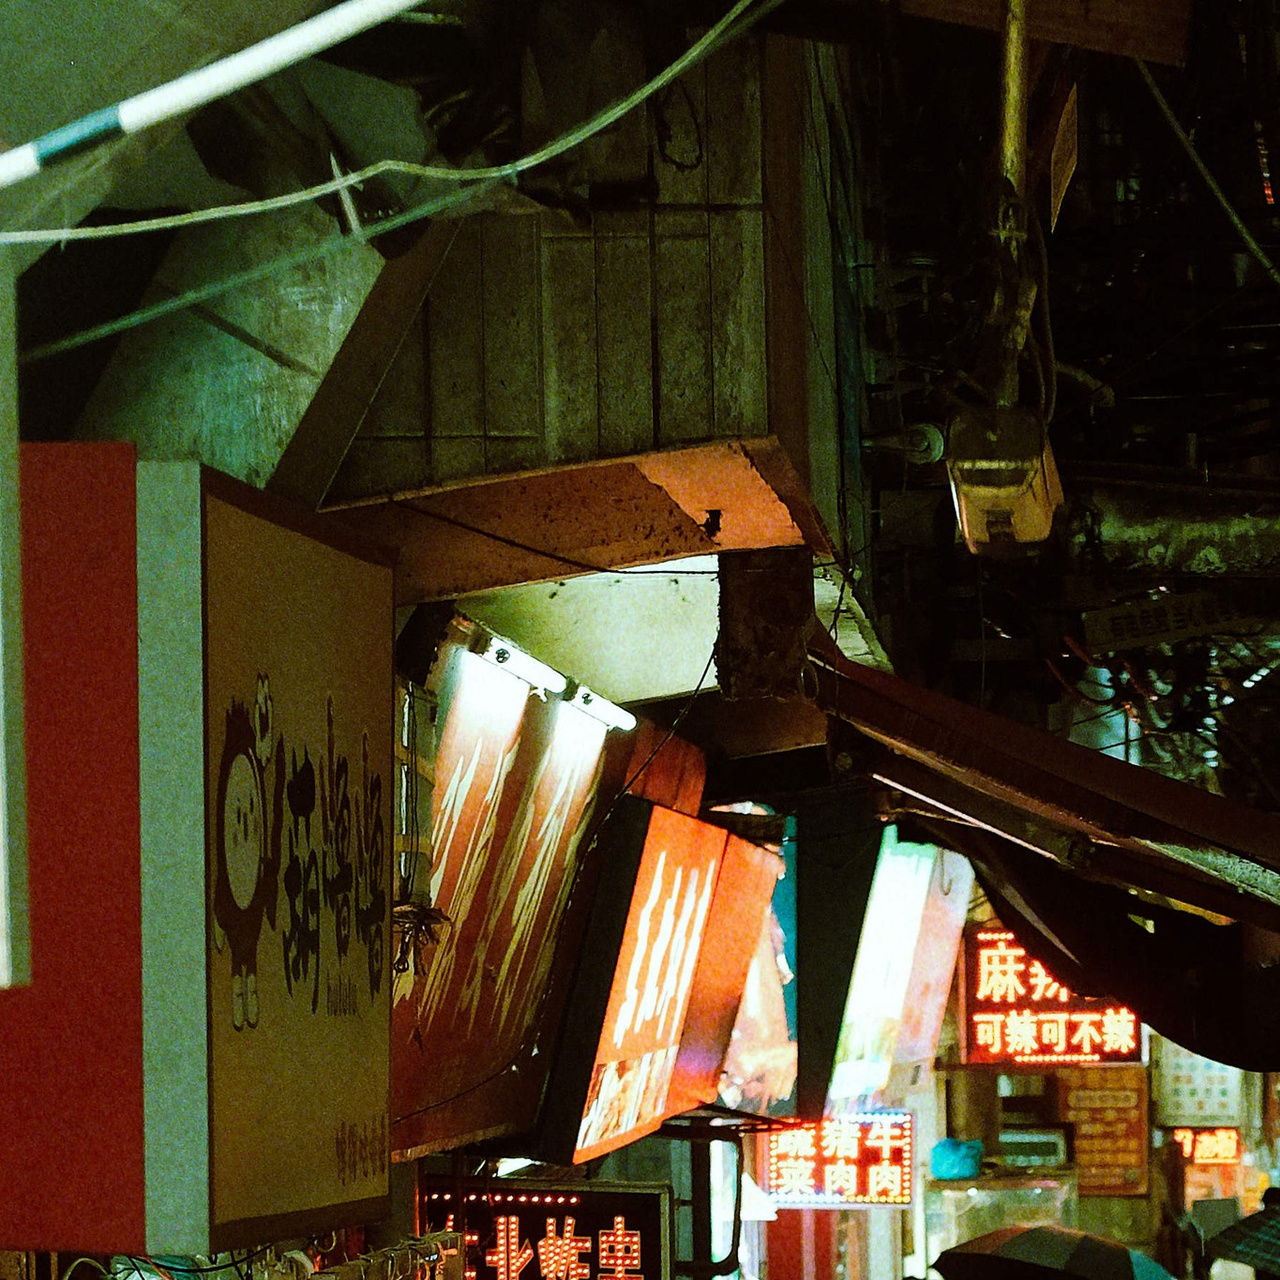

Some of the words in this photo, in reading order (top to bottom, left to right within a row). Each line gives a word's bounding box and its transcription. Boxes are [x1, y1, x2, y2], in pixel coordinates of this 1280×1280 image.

[973, 1007, 1136, 1054] 可辣可不辣
